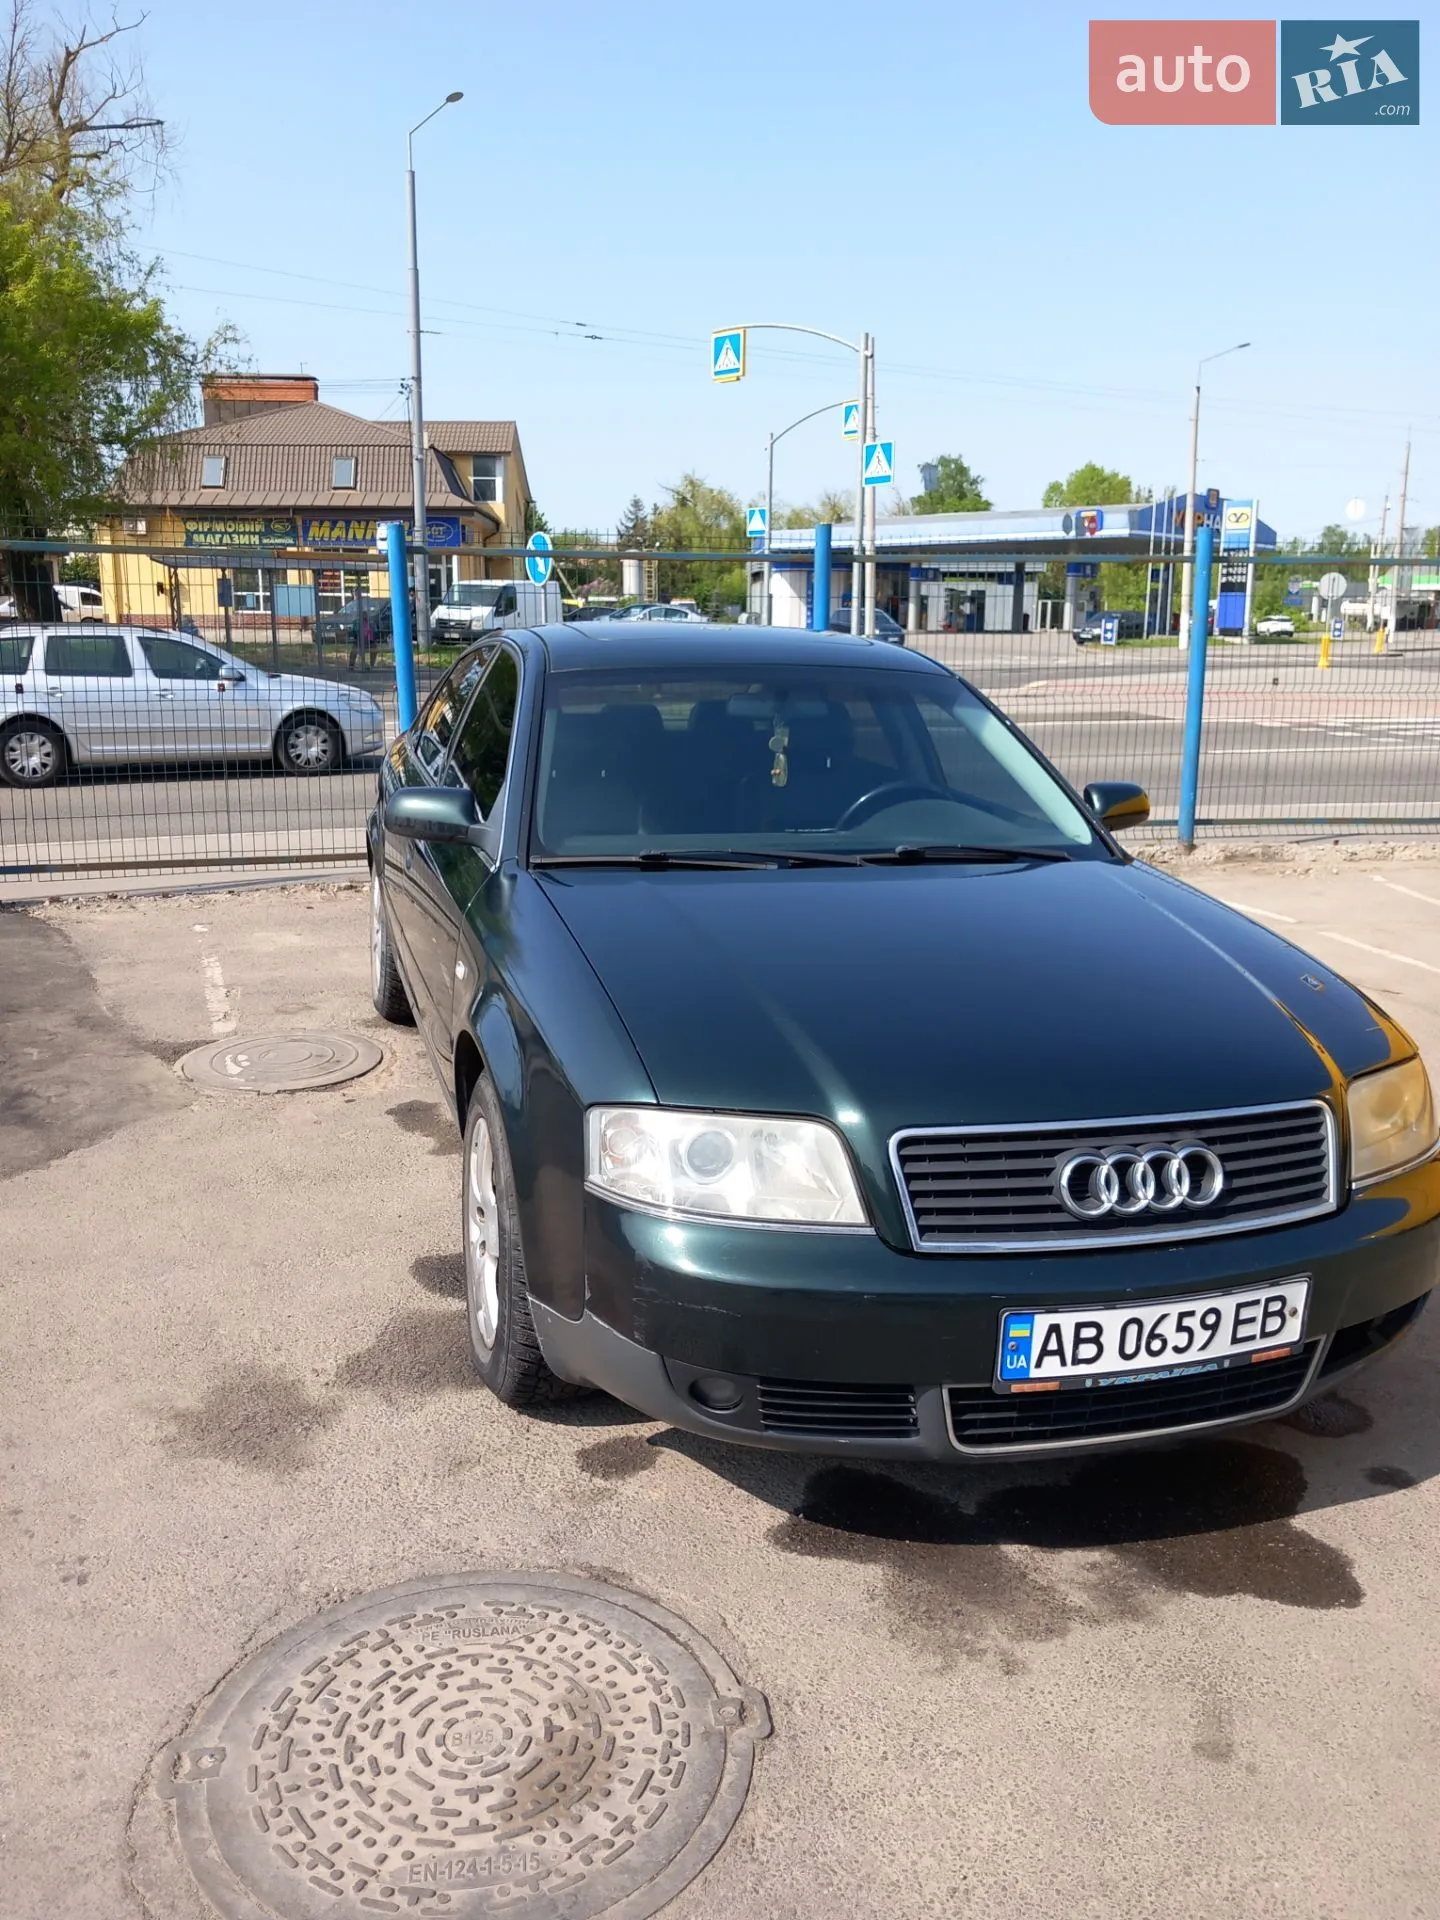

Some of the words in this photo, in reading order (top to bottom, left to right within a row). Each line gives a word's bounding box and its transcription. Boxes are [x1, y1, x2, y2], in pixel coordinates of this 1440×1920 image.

[185, 518, 265, 532] ФІРМОВИЙ
[307, 519, 413, 541] MANNL
[192, 533, 260, 545] МАГАЗИН
[1034, 1321, 1105, 1369] AB
[1117, 1306, 1223, 1361] 0659
[1230, 1294, 1289, 1346] EB
[1006, 1354, 1028, 1370] UA
[421, 1630, 440, 1641] PE
[452, 1729, 494, 1748] B125
[408, 1851, 541, 1884] EN-124-1-5-15
